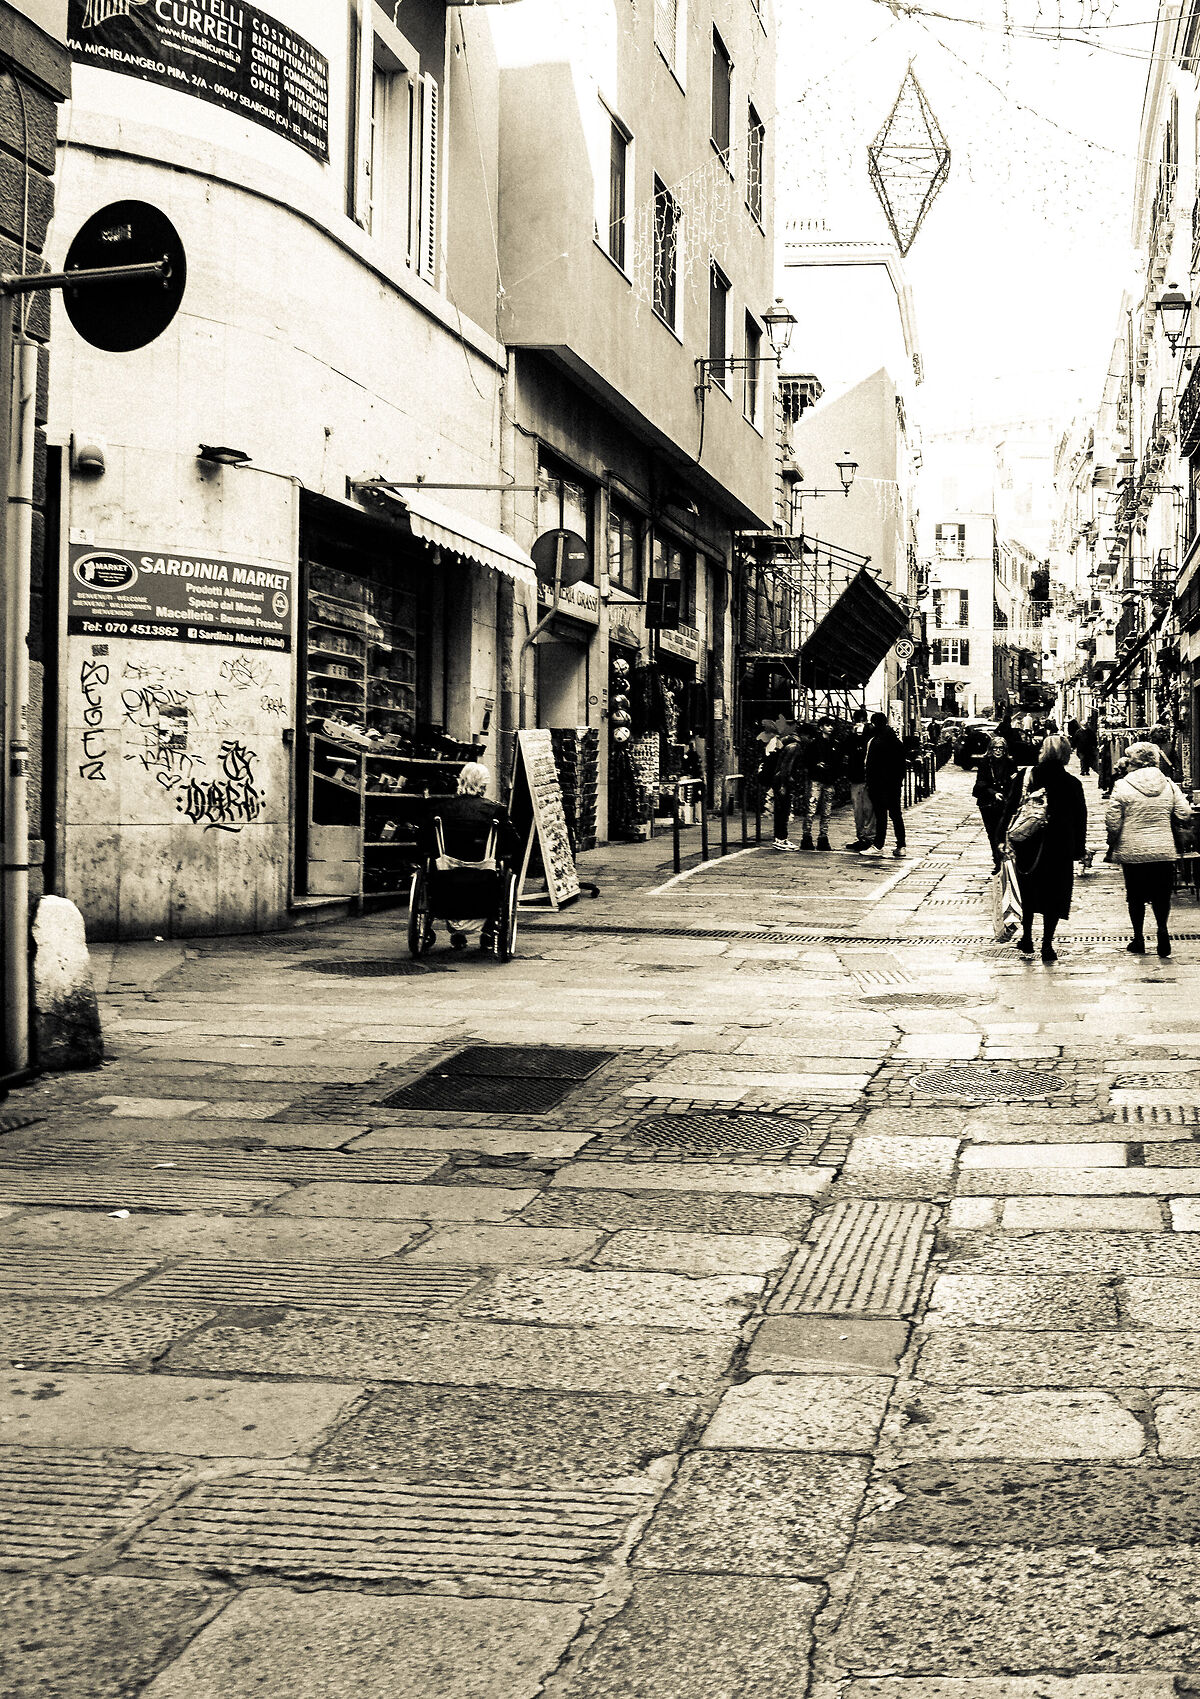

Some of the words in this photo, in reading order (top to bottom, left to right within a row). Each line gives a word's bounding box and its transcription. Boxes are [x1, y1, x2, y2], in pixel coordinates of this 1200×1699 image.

[155, 0, 243, 50] CURRELI
[155, 23, 241, 64] www.fratellicurreli.it
[251, 47, 279, 72] CENTRI
[252, 18, 326, 77] COSTRUZIONI
[252, 32, 327, 90] RISTRUTTURAZIONI
[66, 38, 82, 51] VIA
[84, 43, 166, 73] MICHELANGELO
[191, 75, 207, 89] 2/A
[214, 84, 238, 101] 09047
[239, 95, 276, 121] SELARGIUS
[251, 62, 279, 85] CIVILI
[284, 80, 327, 117] ABITAZIONI
[250, 76, 280, 101] OPERE
[288, 96, 327, 131] PUBBLICHE
[95, 563, 128, 572] MARKET
[139, 557, 228, 582] SARDINIA
[232, 567, 289, 591] MARKET
[186, 583, 222, 596] Prodotti
[224, 587, 264, 601] Alimentari
[188, 597, 219, 609] Spezie
[220, 600, 234, 611] dal
[105, 622, 128, 633] 070
[156, 606, 213, 622] Macelleria
[220, 613, 255, 627] Bevande
[198, 629, 234, 641] Sardinia
[235, 633, 263, 645] Market
